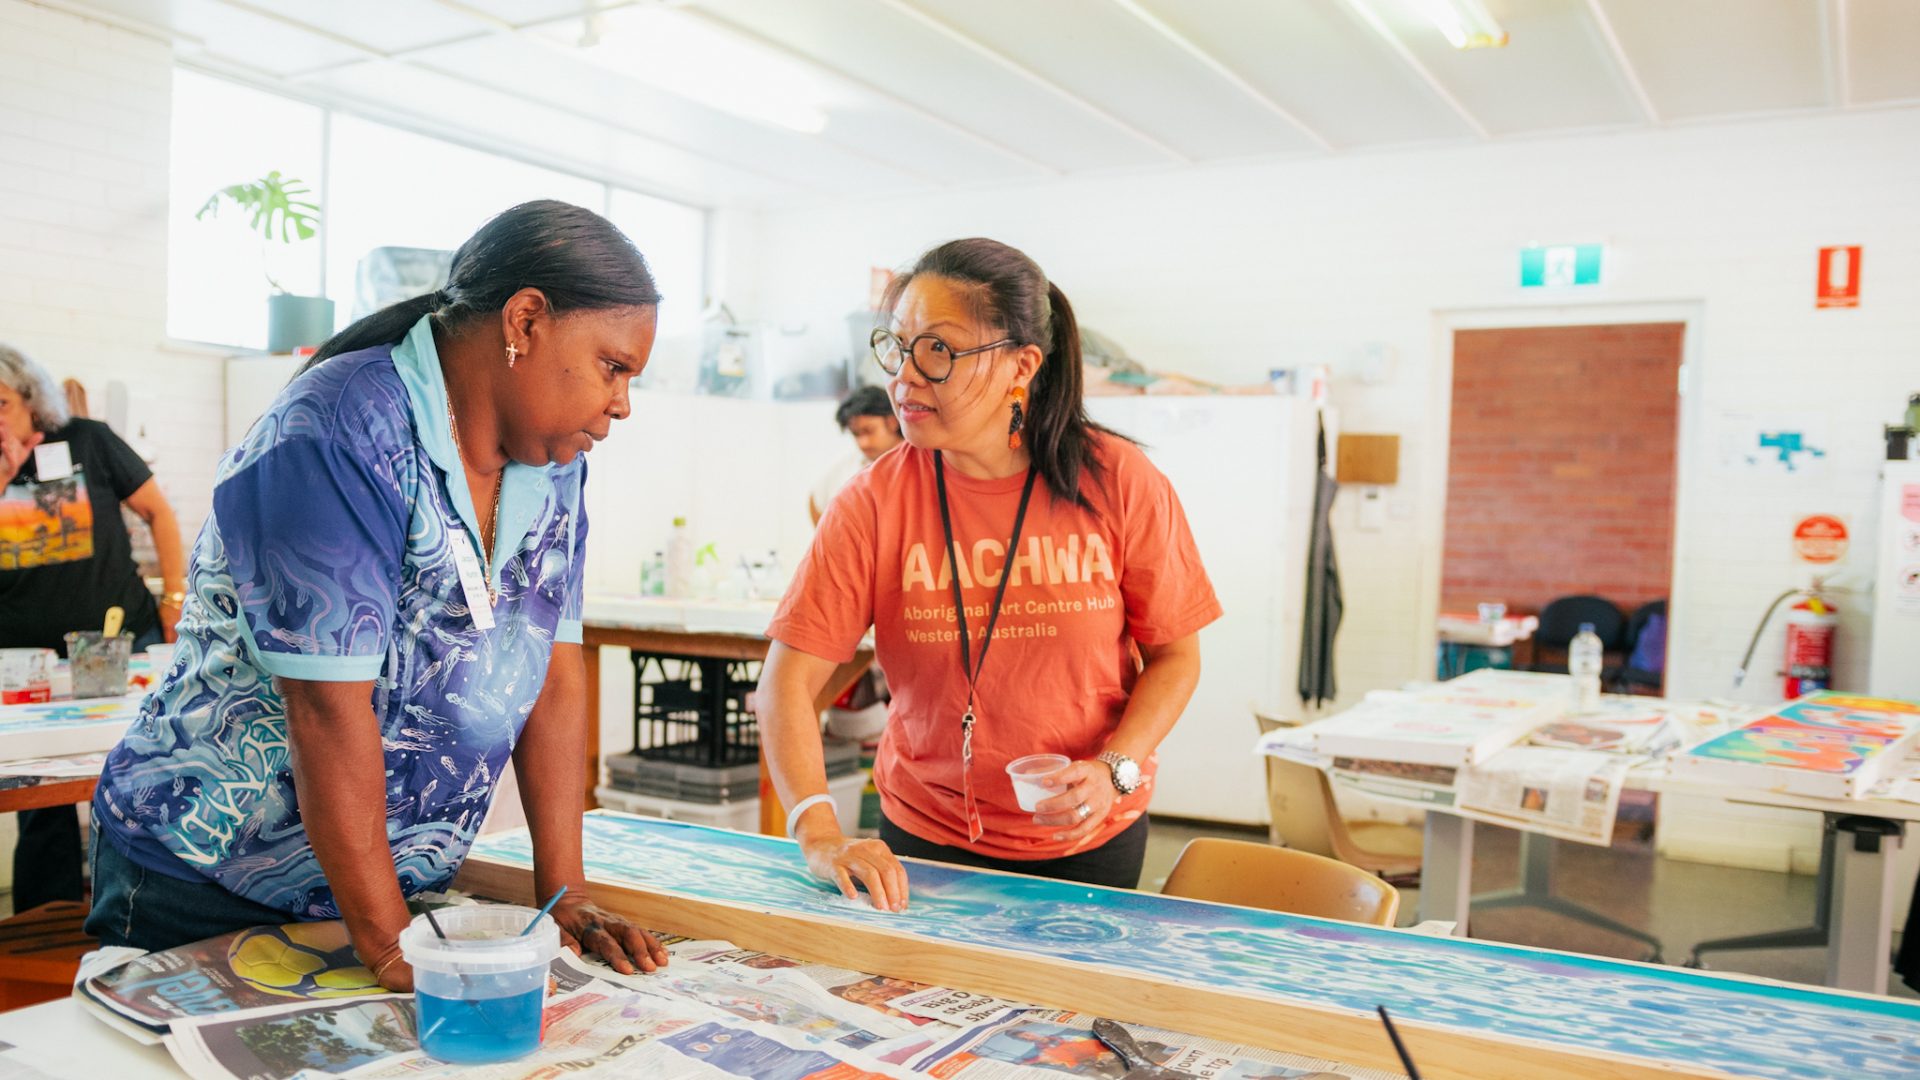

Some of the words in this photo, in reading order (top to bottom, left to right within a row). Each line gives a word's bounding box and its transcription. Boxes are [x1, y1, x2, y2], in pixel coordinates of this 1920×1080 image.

[902, 533, 1115, 592] AACHWA
[903, 602, 989, 622] Aborignal
[1025, 600, 1082, 614] Centre
[1086, 595, 1115, 610] Hub
[977, 623, 1057, 639] Australia
